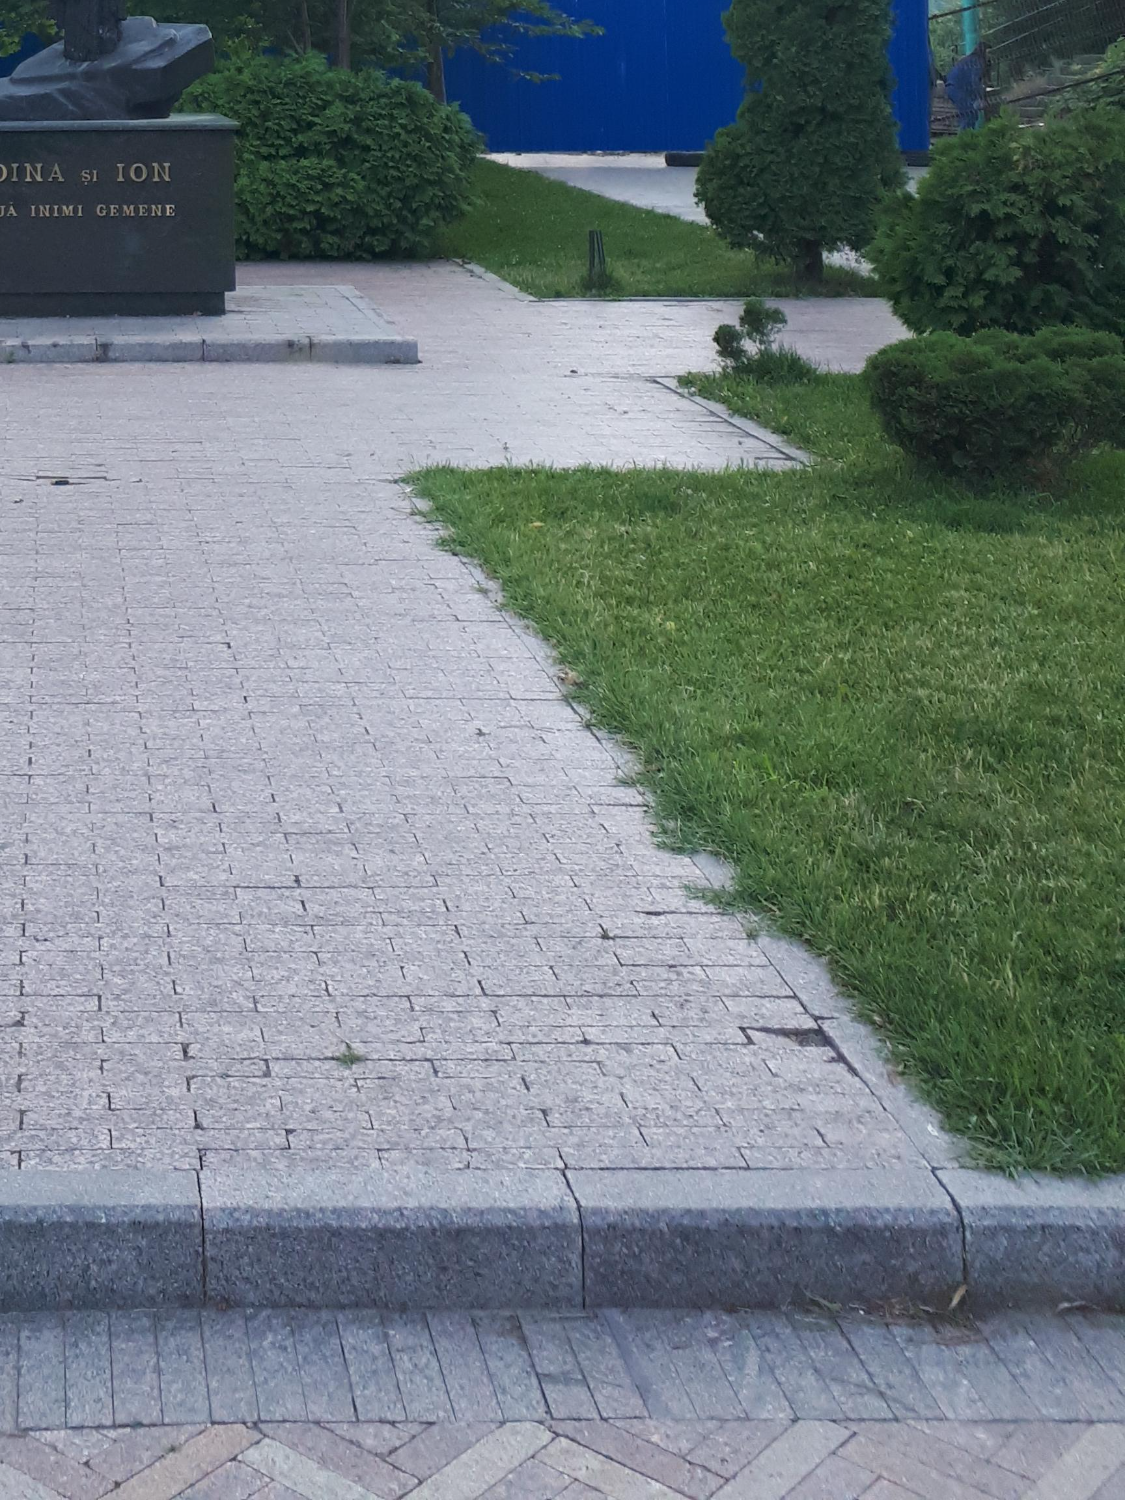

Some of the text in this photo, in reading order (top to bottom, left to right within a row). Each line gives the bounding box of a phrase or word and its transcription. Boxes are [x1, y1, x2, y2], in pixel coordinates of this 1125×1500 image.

[116, 162, 171, 182] ION
[30, 204, 84, 218] INIMI
[96, 204, 176, 217] GEMENE
